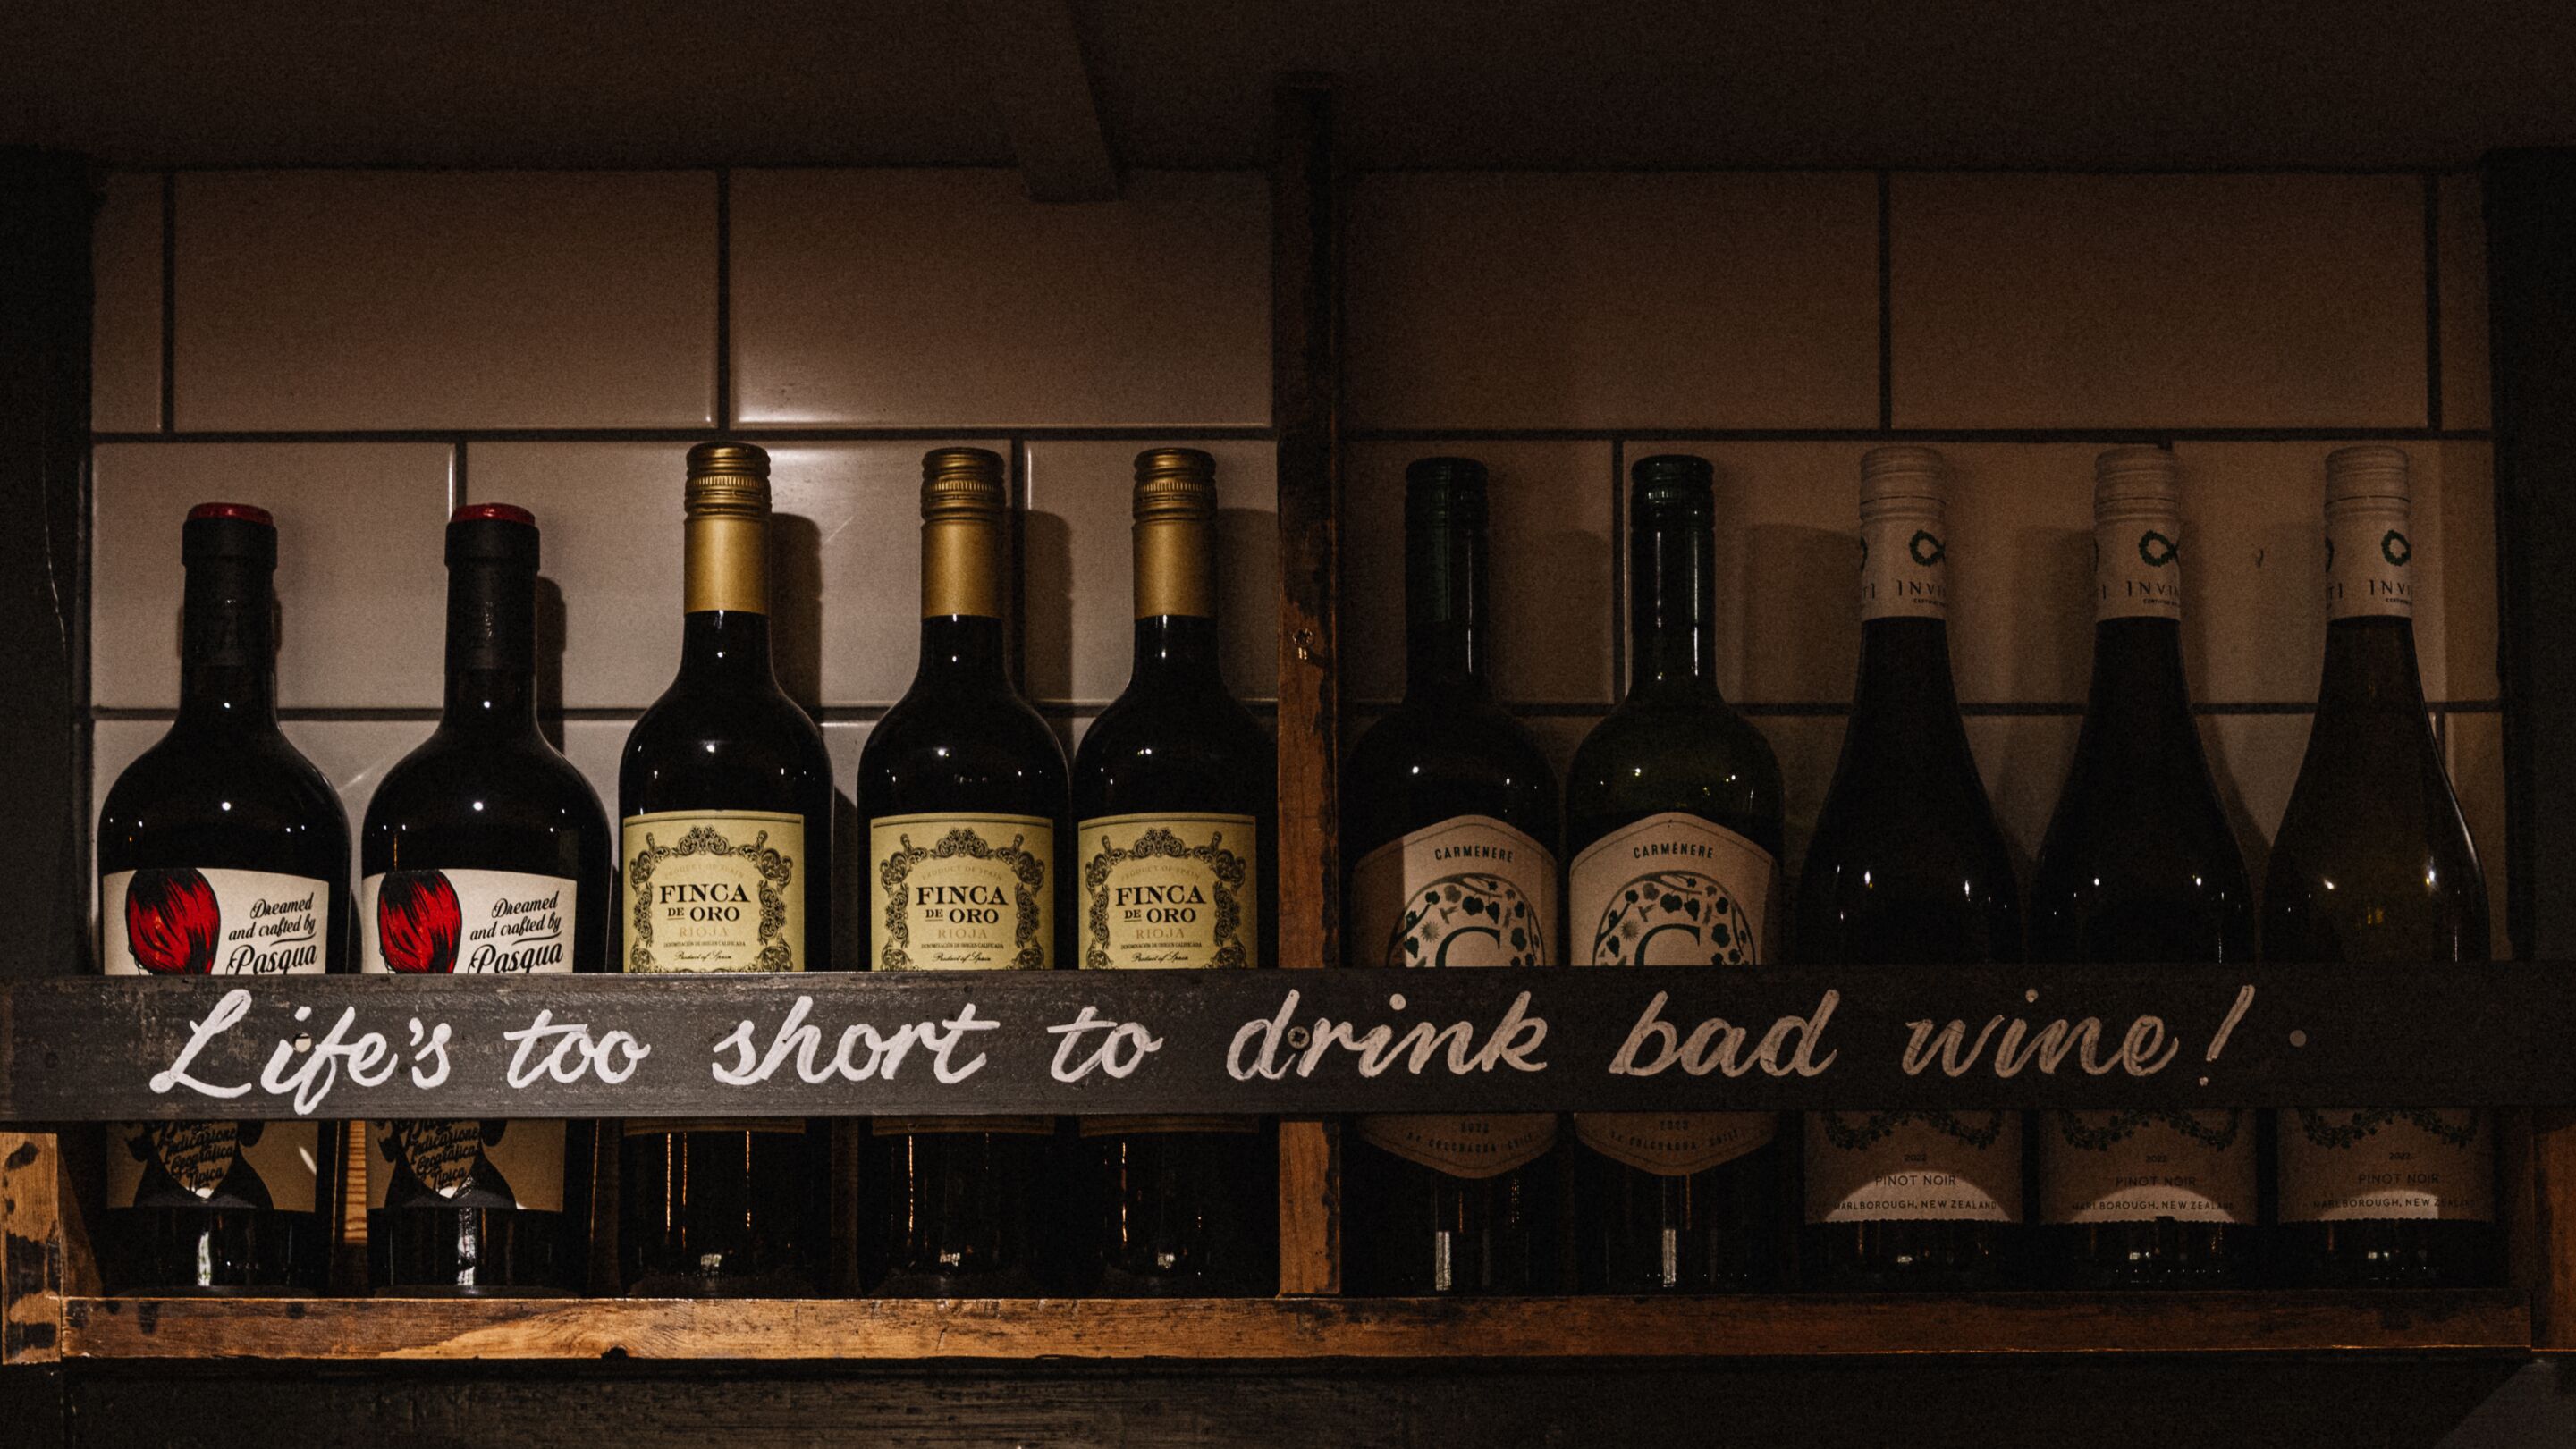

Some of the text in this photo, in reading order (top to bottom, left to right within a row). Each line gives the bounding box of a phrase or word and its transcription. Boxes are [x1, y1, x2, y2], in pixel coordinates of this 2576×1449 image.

[659, 883, 750, 905] FINCA
[916, 886, 1009, 906] FINCA
[1115, 885, 1206, 906] FINCA
[250, 892, 314, 919] Dreamed
[492, 890, 560, 918] Dreamed
[667, 906, 740, 922] DE ORO
[925, 908, 999, 923] DE ORO
[1124, 907, 1196, 923] DE ORO
[228, 913, 316, 941] and crafted by
[469, 911, 562, 941] and crafted by
[680, 926, 729, 938] RIOJA
[1136, 928, 1185, 939] RIOJA
[938, 929, 987, 939] RIOJA
[225, 944, 317, 975] Pasqua
[467, 943, 563, 974] Pasqua
[674, 950, 701, 961] Product
[711, 950, 731, 961] Spain
[932, 951, 991, 963] Product of Spain
[1131, 951, 1188, 963] Product of Spain
[150, 989, 451, 1116] Life's
[504, 1009, 651, 1088] too
[712, 995, 1000, 1085] short
[1047, 1007, 1163, 1084] to
[1227, 989, 1548, 1080] drink
[1609, 989, 1840, 1077] bad
[1875, 1175, 1956, 1186] PINOT NOIR
[2116, 1176, 2197, 1187] PINOT NOIR
[2359, 1174, 2439, 1184] PINOT NOIR
[1921, 1200, 1947, 1209] NEW
[1951, 1200, 1997, 1209] ZEALAND
[2162, 1200, 2187, 1209] NEW
[2190, 1200, 2234, 1210] ZEALAND
[2405, 1198, 2429, 1207] NEW
